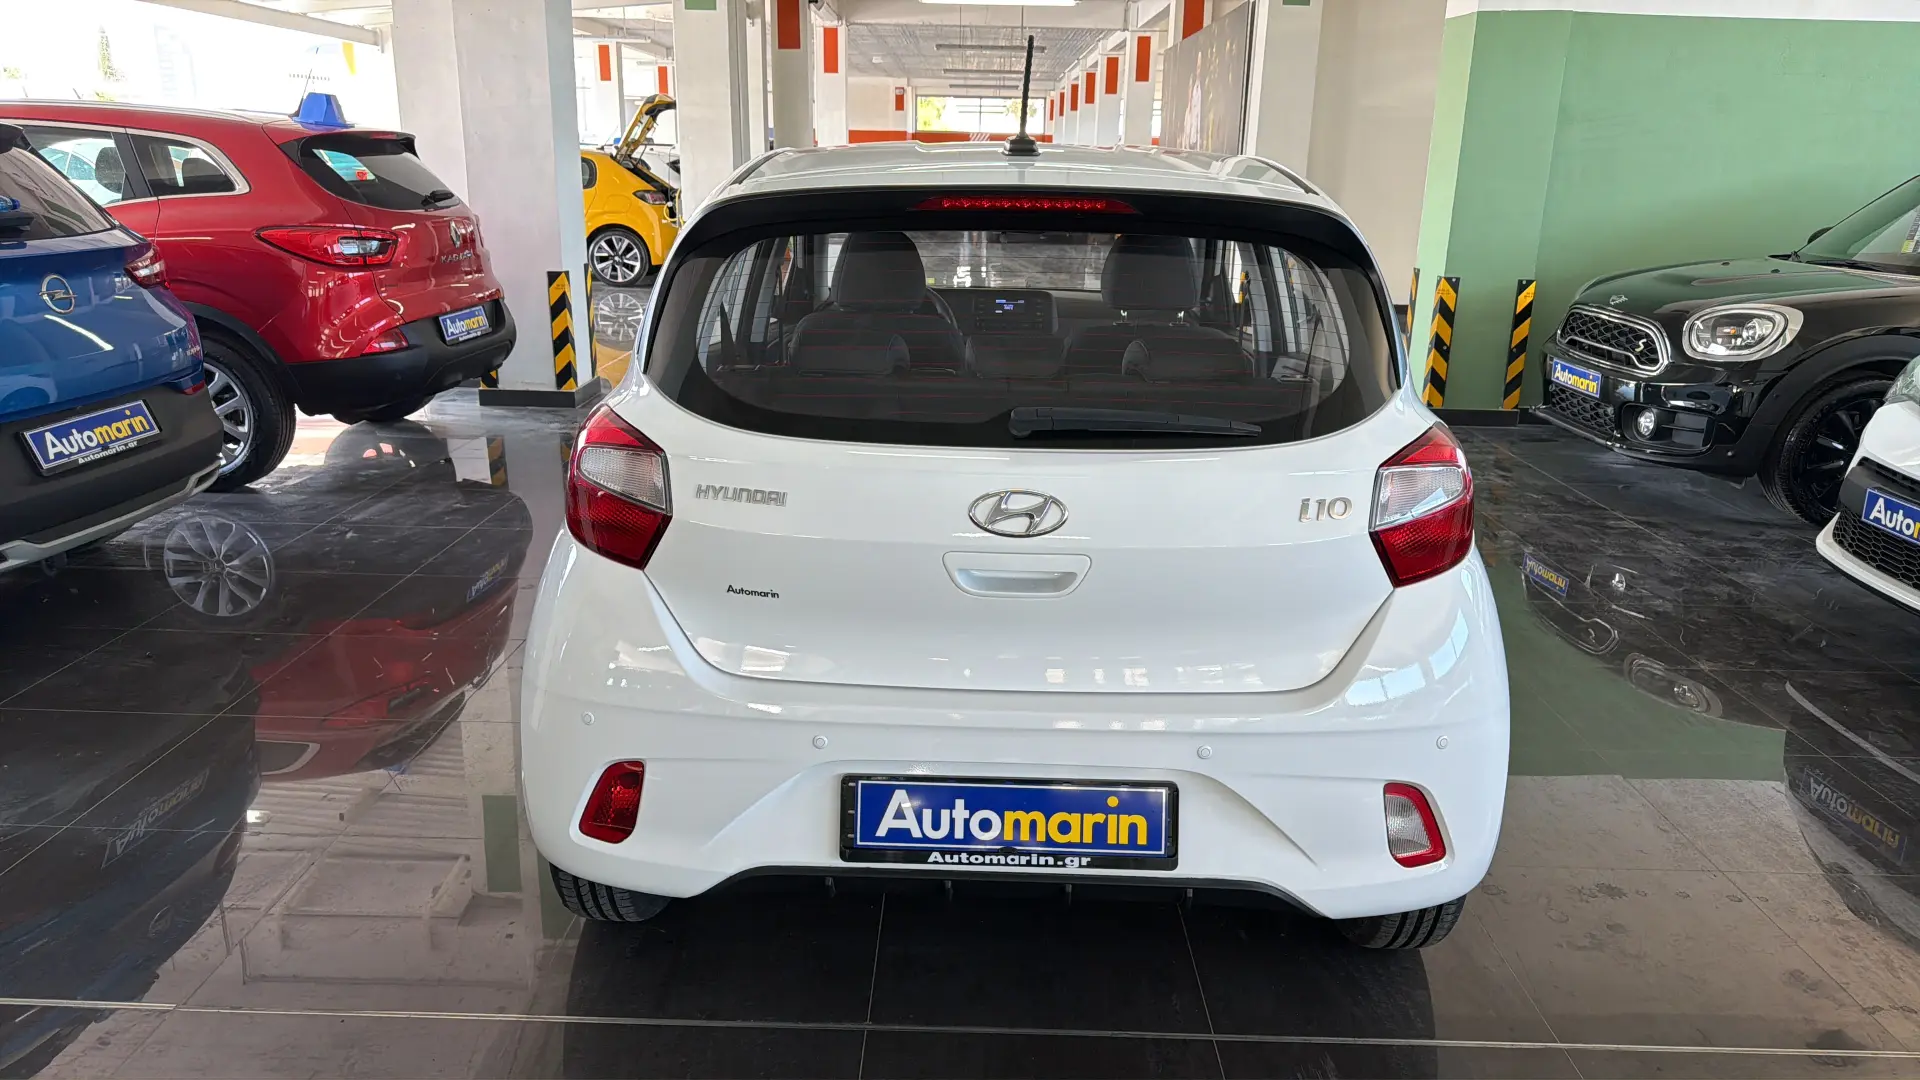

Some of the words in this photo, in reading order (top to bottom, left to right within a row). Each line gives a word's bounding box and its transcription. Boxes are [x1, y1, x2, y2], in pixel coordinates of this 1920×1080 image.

[1554, 363, 1597, 393] Automarin
[44, 410, 149, 460] Automarin
[78, 440, 138, 465] Automarin.gr
[695, 484, 788, 507] HYUNDAI
[1299, 496, 1352, 523] i10
[726, 584, 780, 599] Automarin
[875, 789, 1147, 845] Automarin
[927, 852, 1091, 868] Automarin.gr
